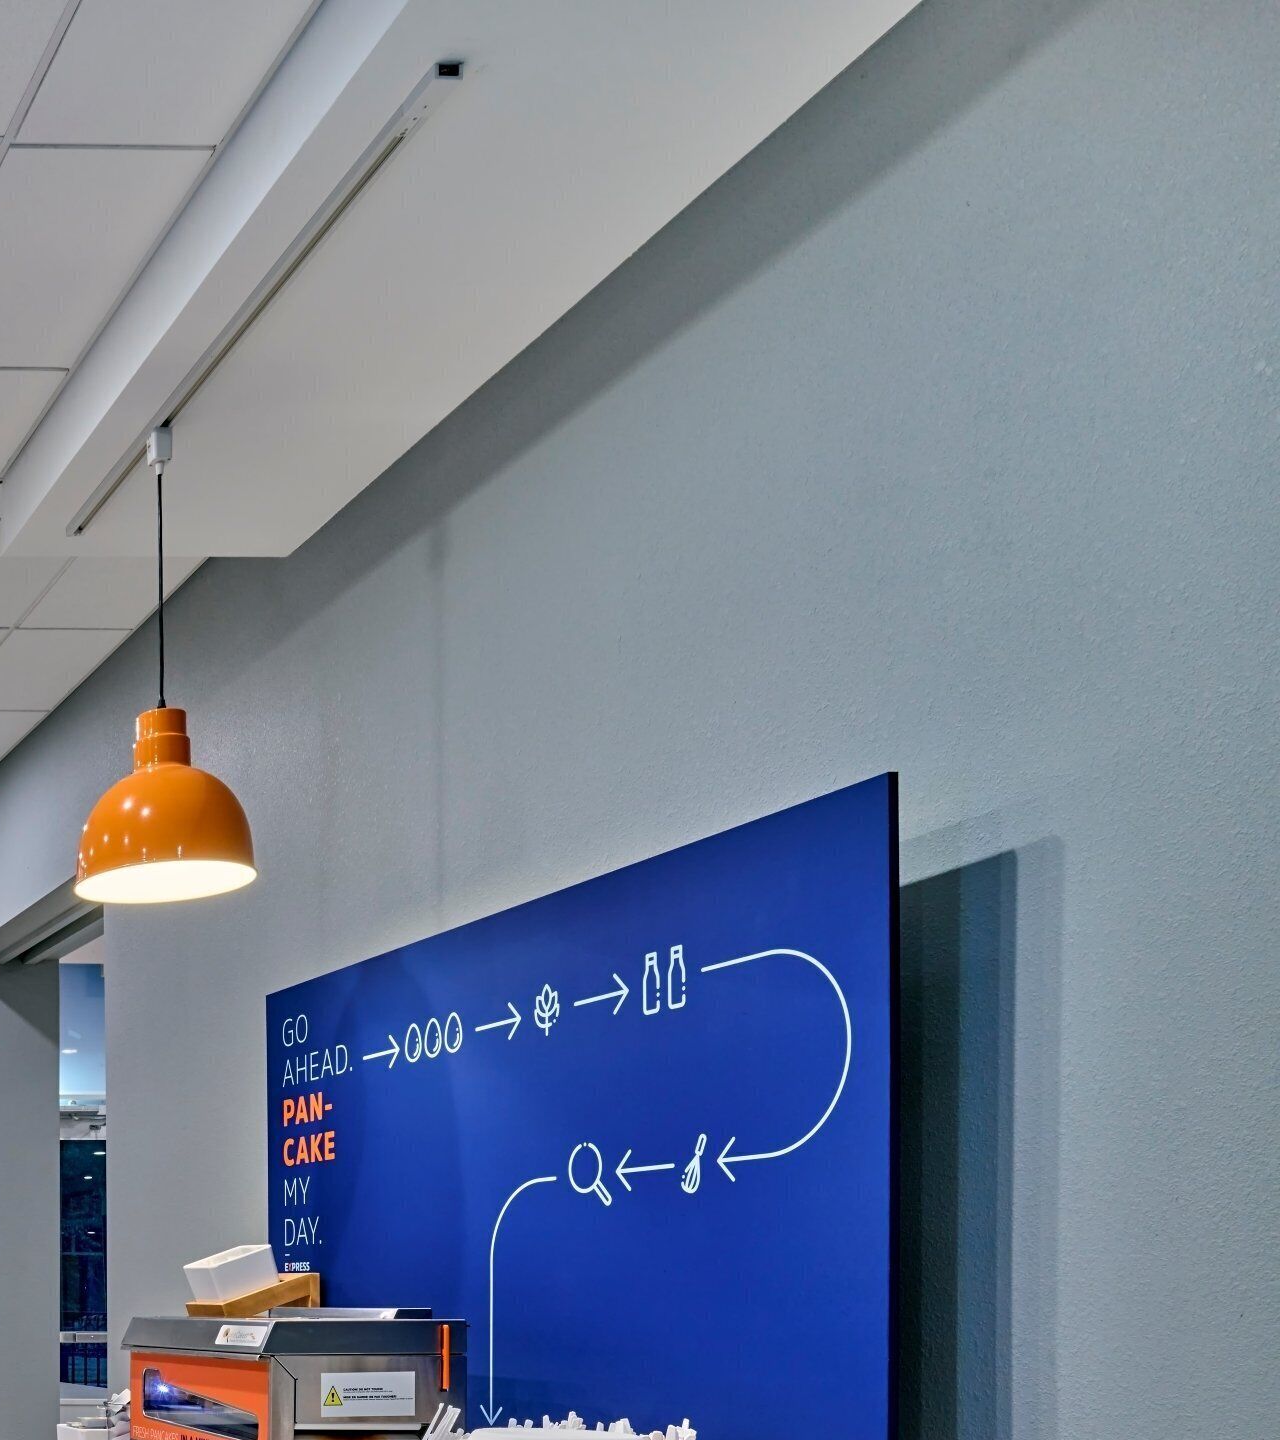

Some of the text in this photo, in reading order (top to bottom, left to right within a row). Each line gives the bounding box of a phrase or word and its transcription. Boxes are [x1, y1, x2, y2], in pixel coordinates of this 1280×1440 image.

[282, 1014, 309, 1047] GO
[282, 1044, 354, 1088] AHEAD.
[282, 1091, 333, 1127] PAN-
[282, 1130, 336, 1167] CAKE
[283, 1176, 311, 1207] MY
[284, 1216, 323, 1247] DAY.
[284, 1261, 310, 1271] EXPRESS
